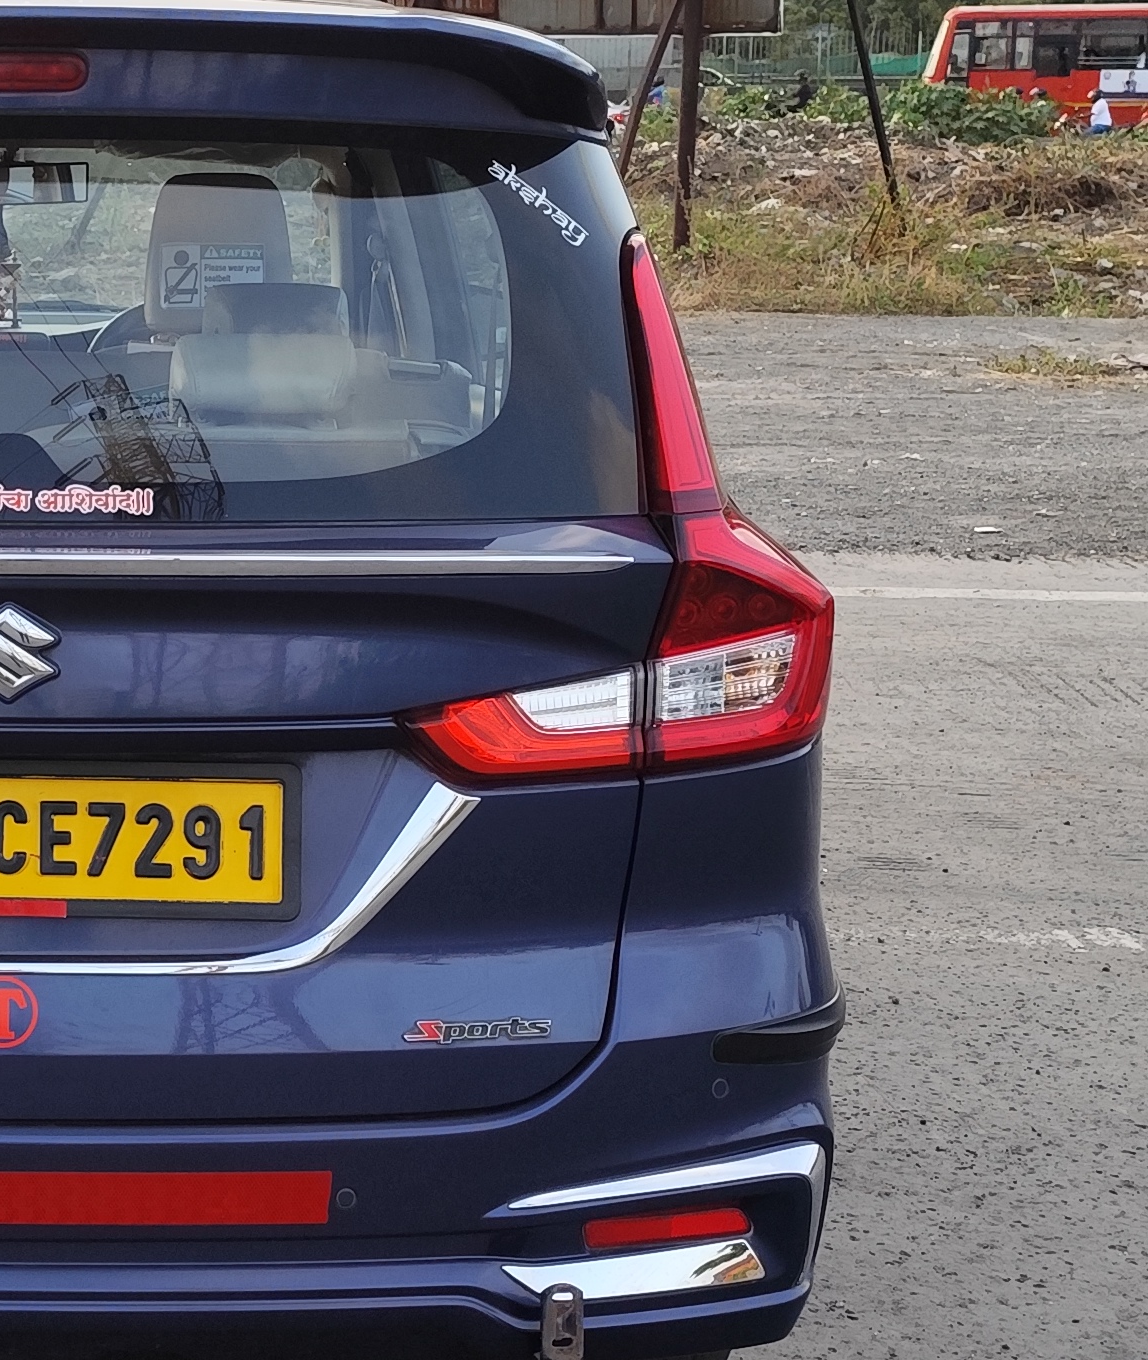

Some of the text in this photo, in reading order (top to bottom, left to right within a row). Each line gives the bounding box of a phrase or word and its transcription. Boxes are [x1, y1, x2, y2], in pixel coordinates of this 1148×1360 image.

[219, 248, 262, 258] SAFETY
[204, 264, 226, 272] Please
[246, 265, 260, 273] your
[403, 1016, 552, 1045] Sports
